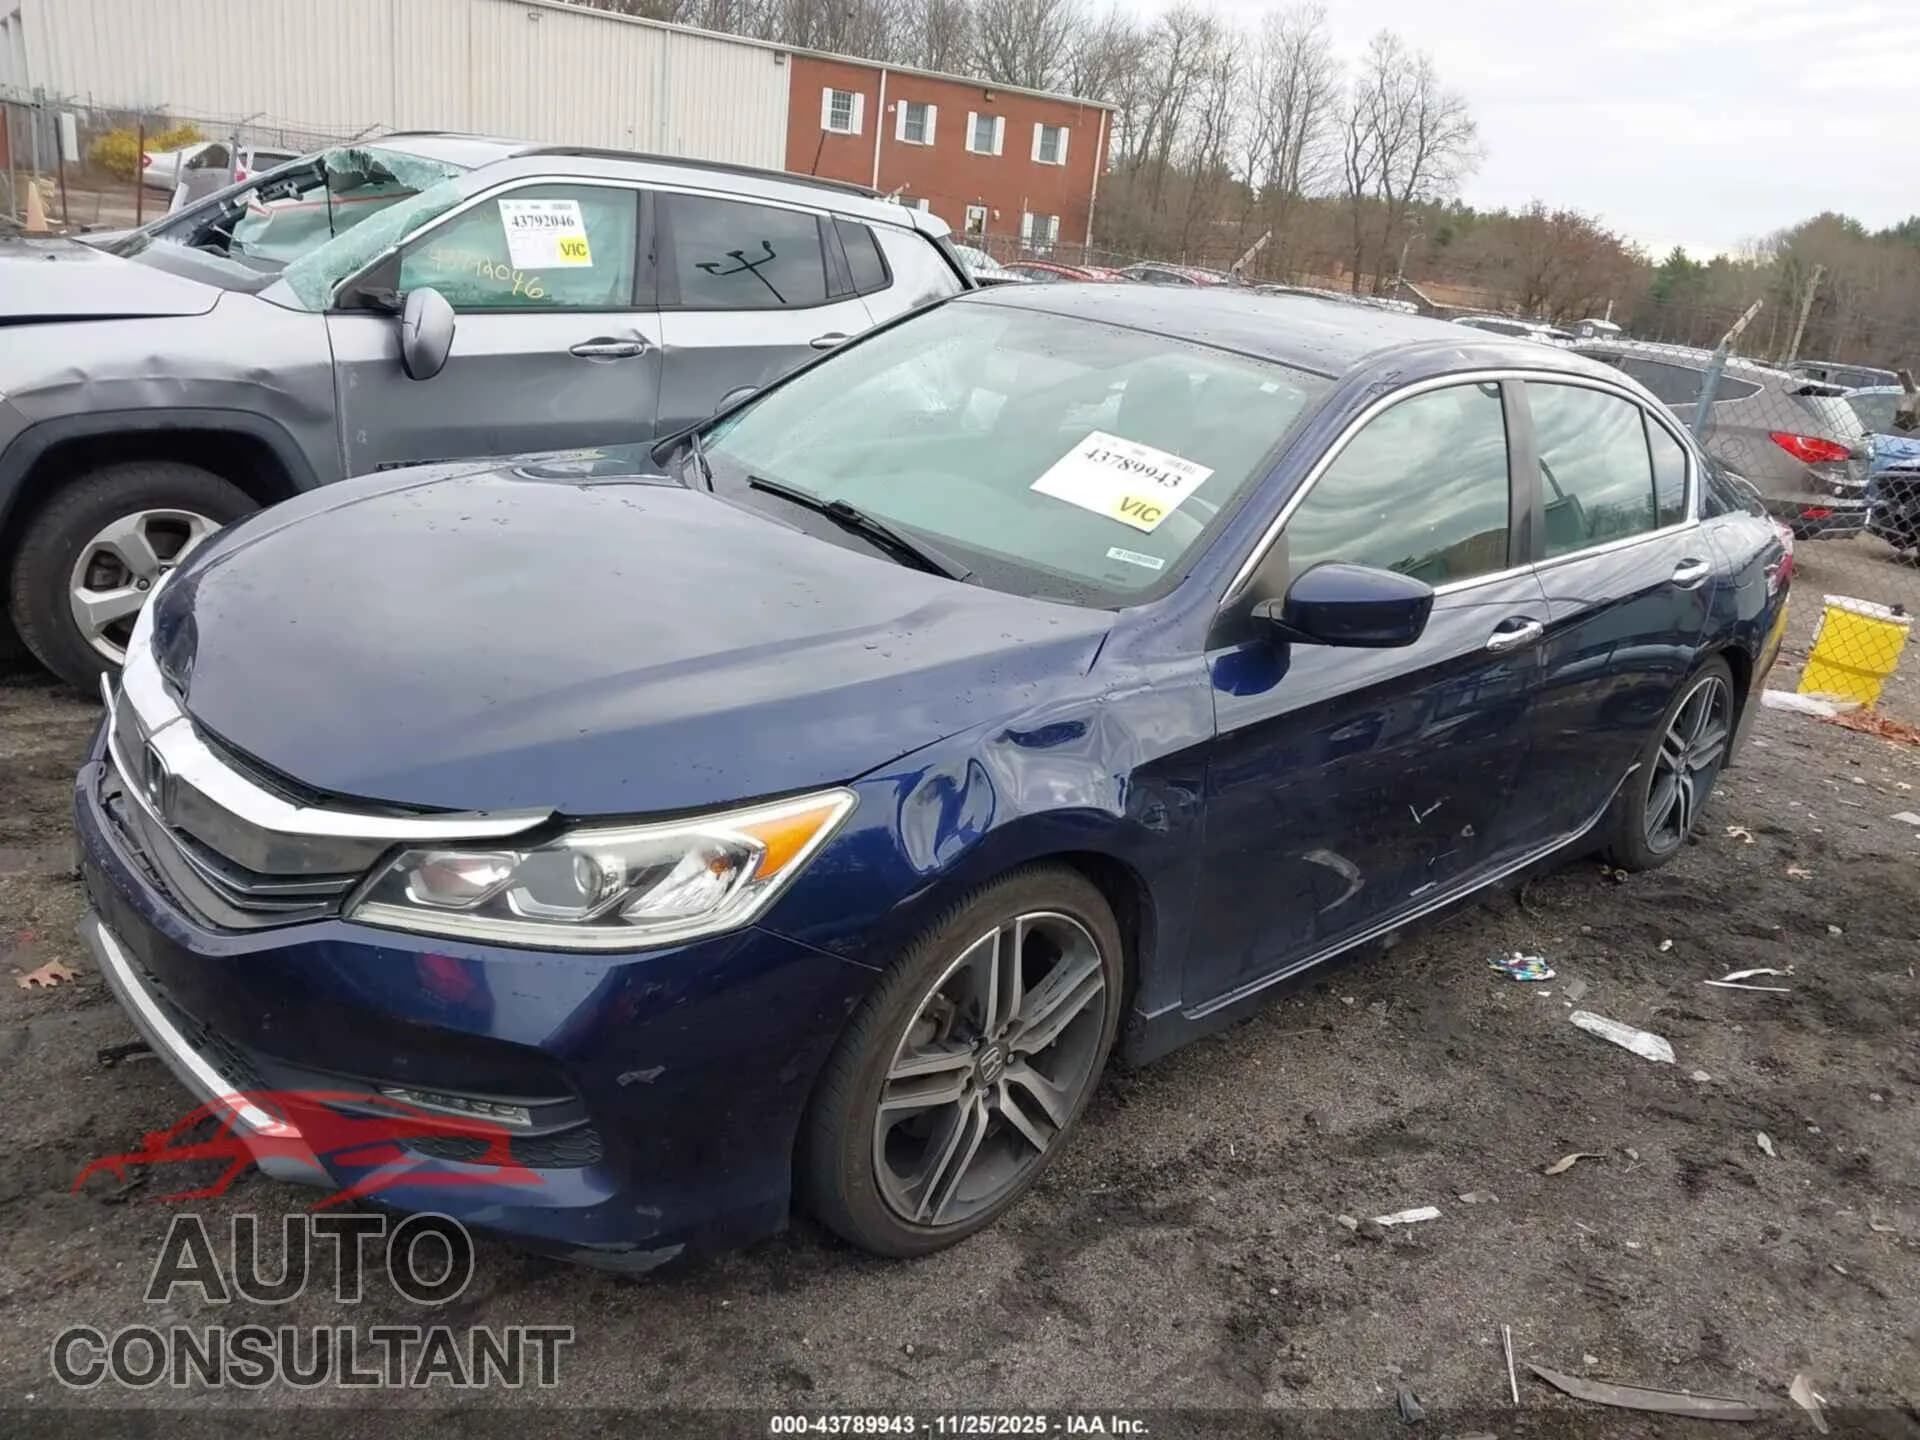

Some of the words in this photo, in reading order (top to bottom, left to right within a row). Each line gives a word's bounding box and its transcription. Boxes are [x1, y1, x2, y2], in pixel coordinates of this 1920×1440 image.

[511, 214, 575, 228] 43792046
[560, 242, 587, 257] VIC
[1084, 448, 1183, 488] 43789943
[1120, 496, 1161, 523] VIC
